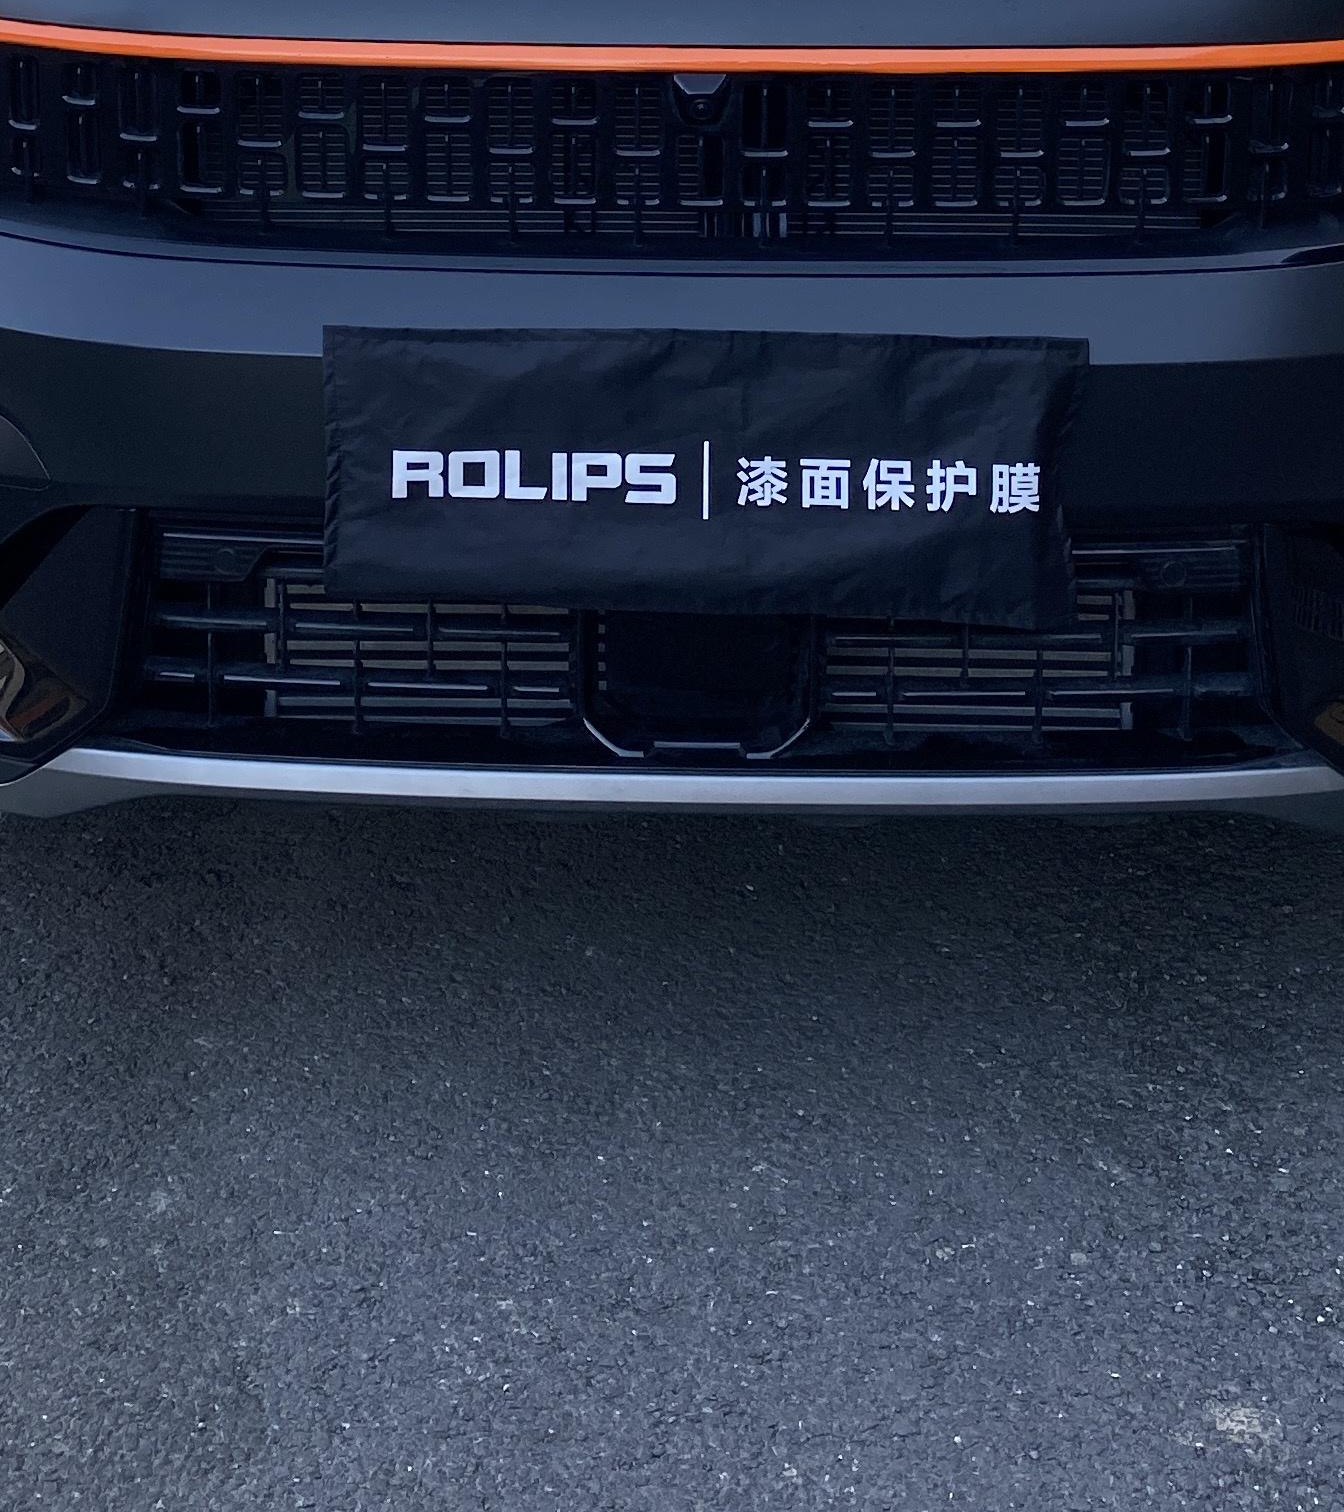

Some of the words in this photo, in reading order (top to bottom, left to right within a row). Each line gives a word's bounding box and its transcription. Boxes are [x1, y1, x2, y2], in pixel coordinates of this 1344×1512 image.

[390, 449, 677, 505] ROLIPS
[735, 455, 1042, 515] 漆面保护膜
